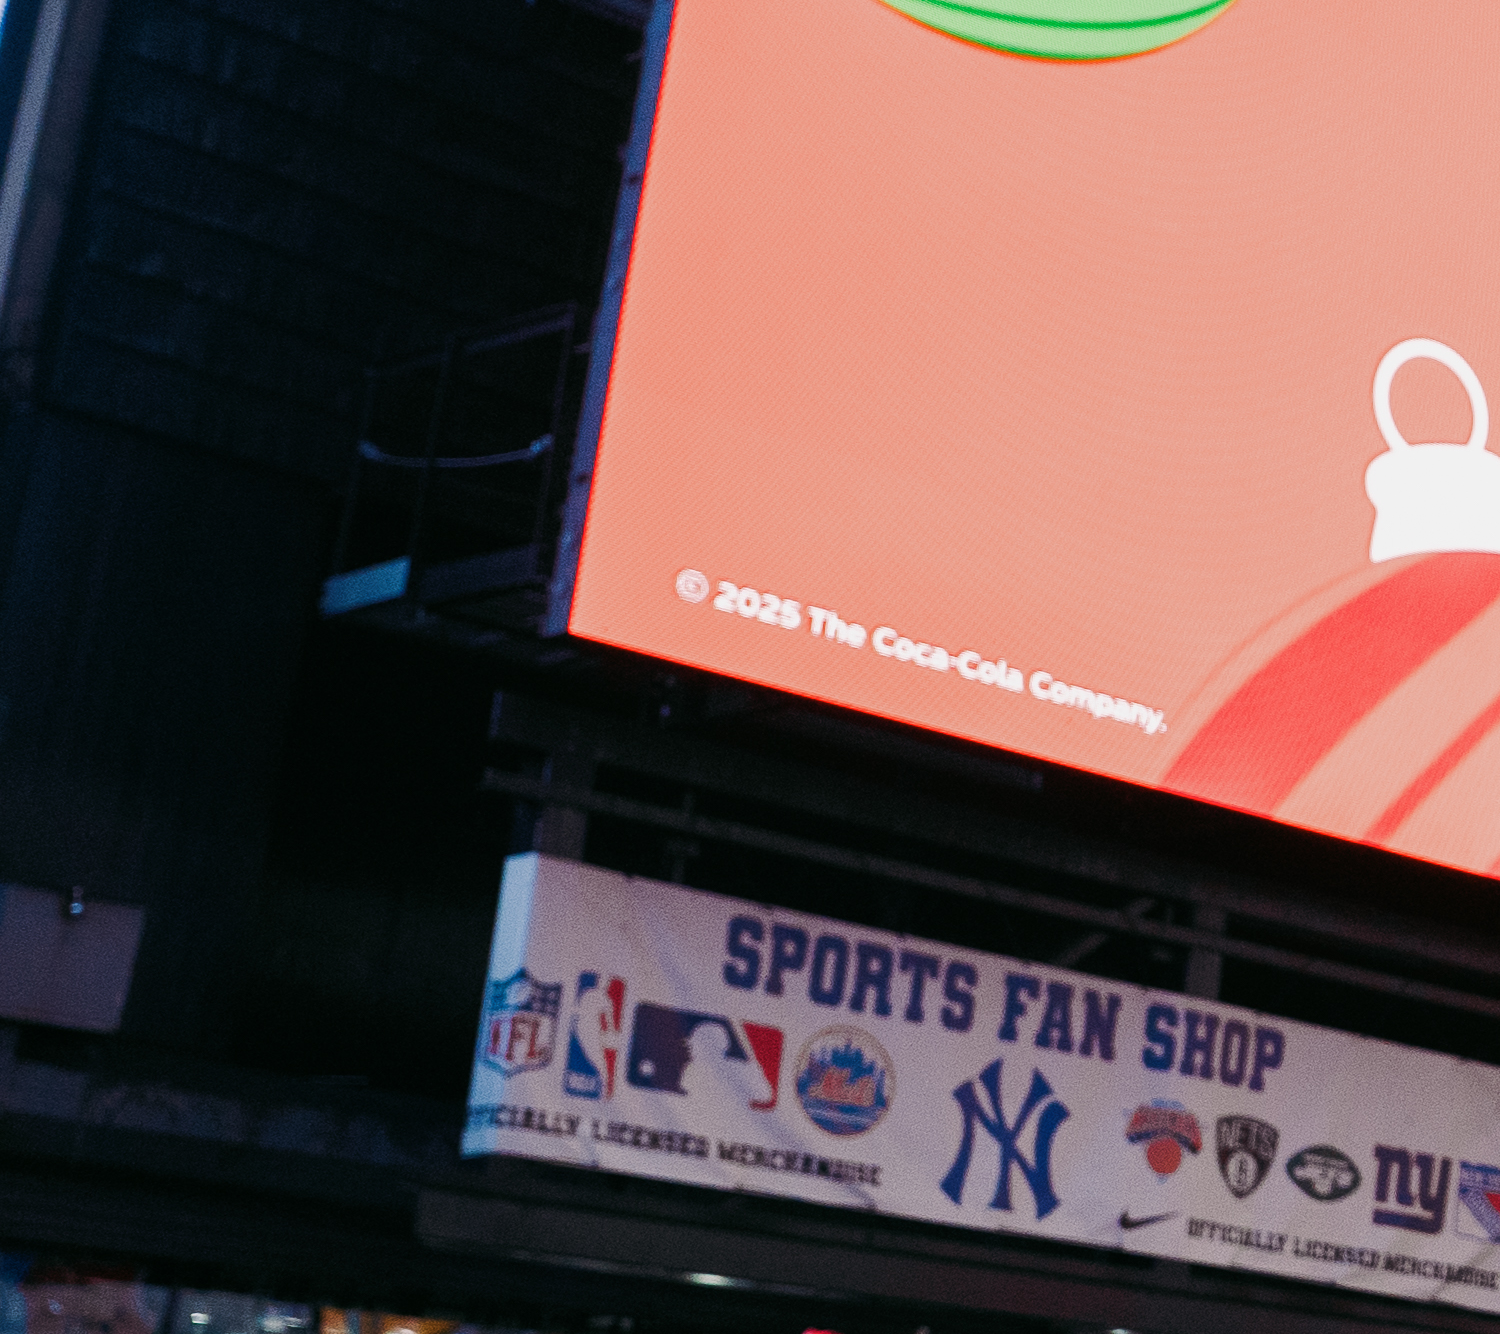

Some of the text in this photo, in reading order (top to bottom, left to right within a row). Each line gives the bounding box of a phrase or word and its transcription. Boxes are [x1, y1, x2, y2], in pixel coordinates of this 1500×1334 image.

[714, 580, 801, 630] 2025
[808, 605, 867, 649] The
[872, 627, 1024, 694] Coca-Cola
[1030, 671, 1167, 735] Company.
[724, 915, 1286, 1091] SPORTS FAN SHOP
